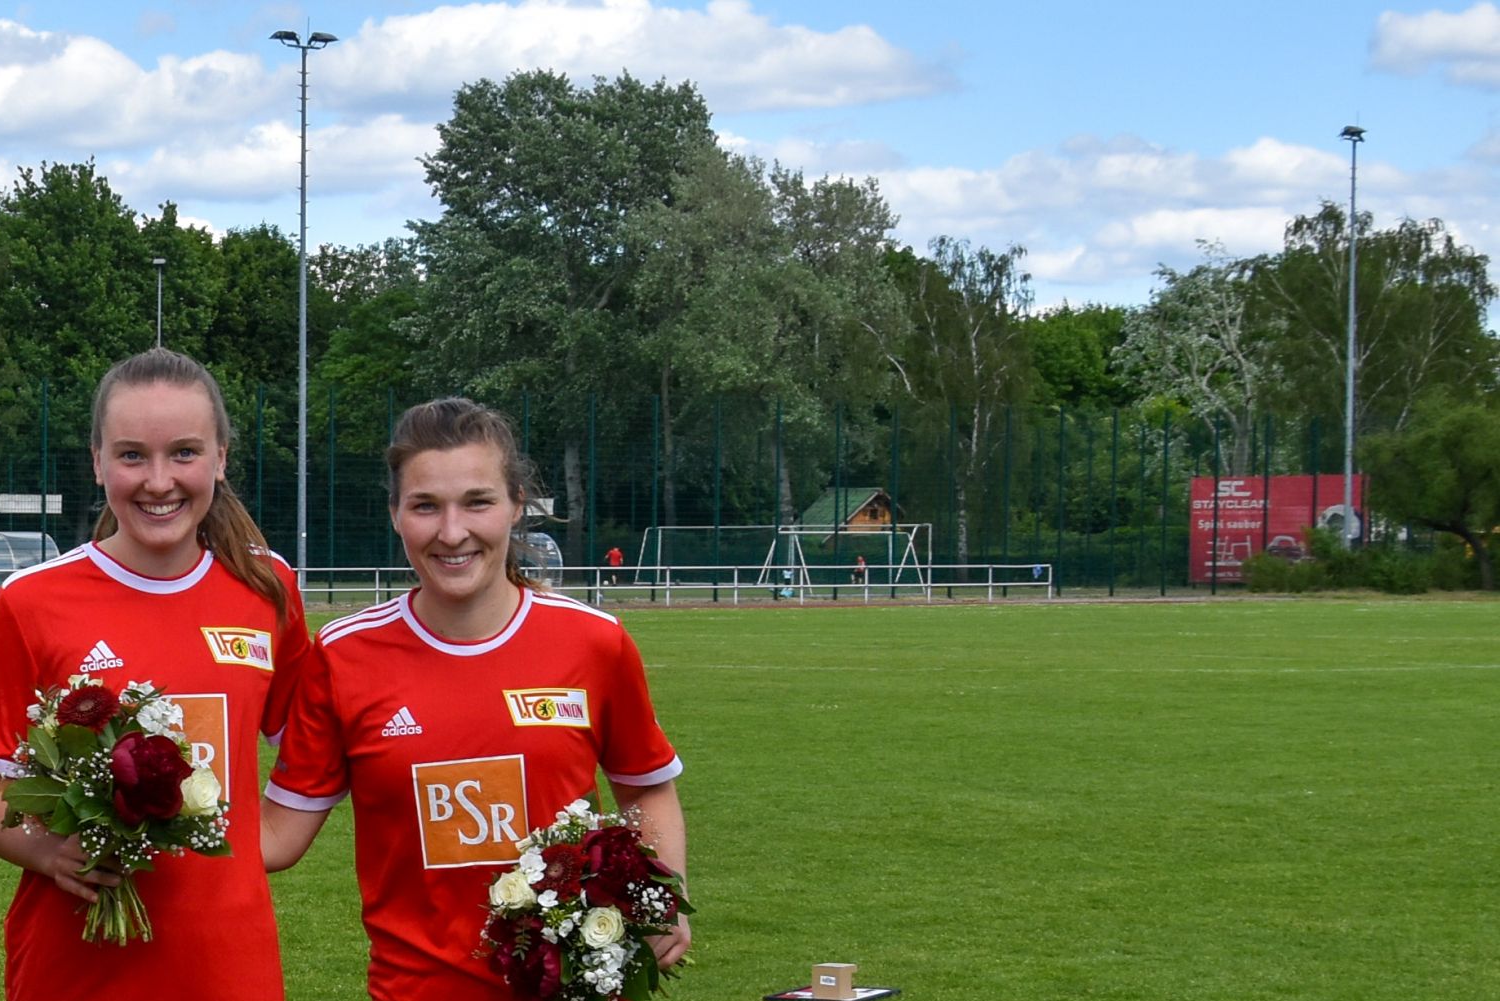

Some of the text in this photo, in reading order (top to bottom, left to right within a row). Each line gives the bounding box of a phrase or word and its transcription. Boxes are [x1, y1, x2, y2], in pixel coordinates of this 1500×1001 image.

[1226, 520, 1262, 529] sauber
[79, 657, 124, 673] adidas
[556, 702, 583, 719] UNION
[381, 724, 423, 737] adidas
[426, 780, 521, 846] BSR
